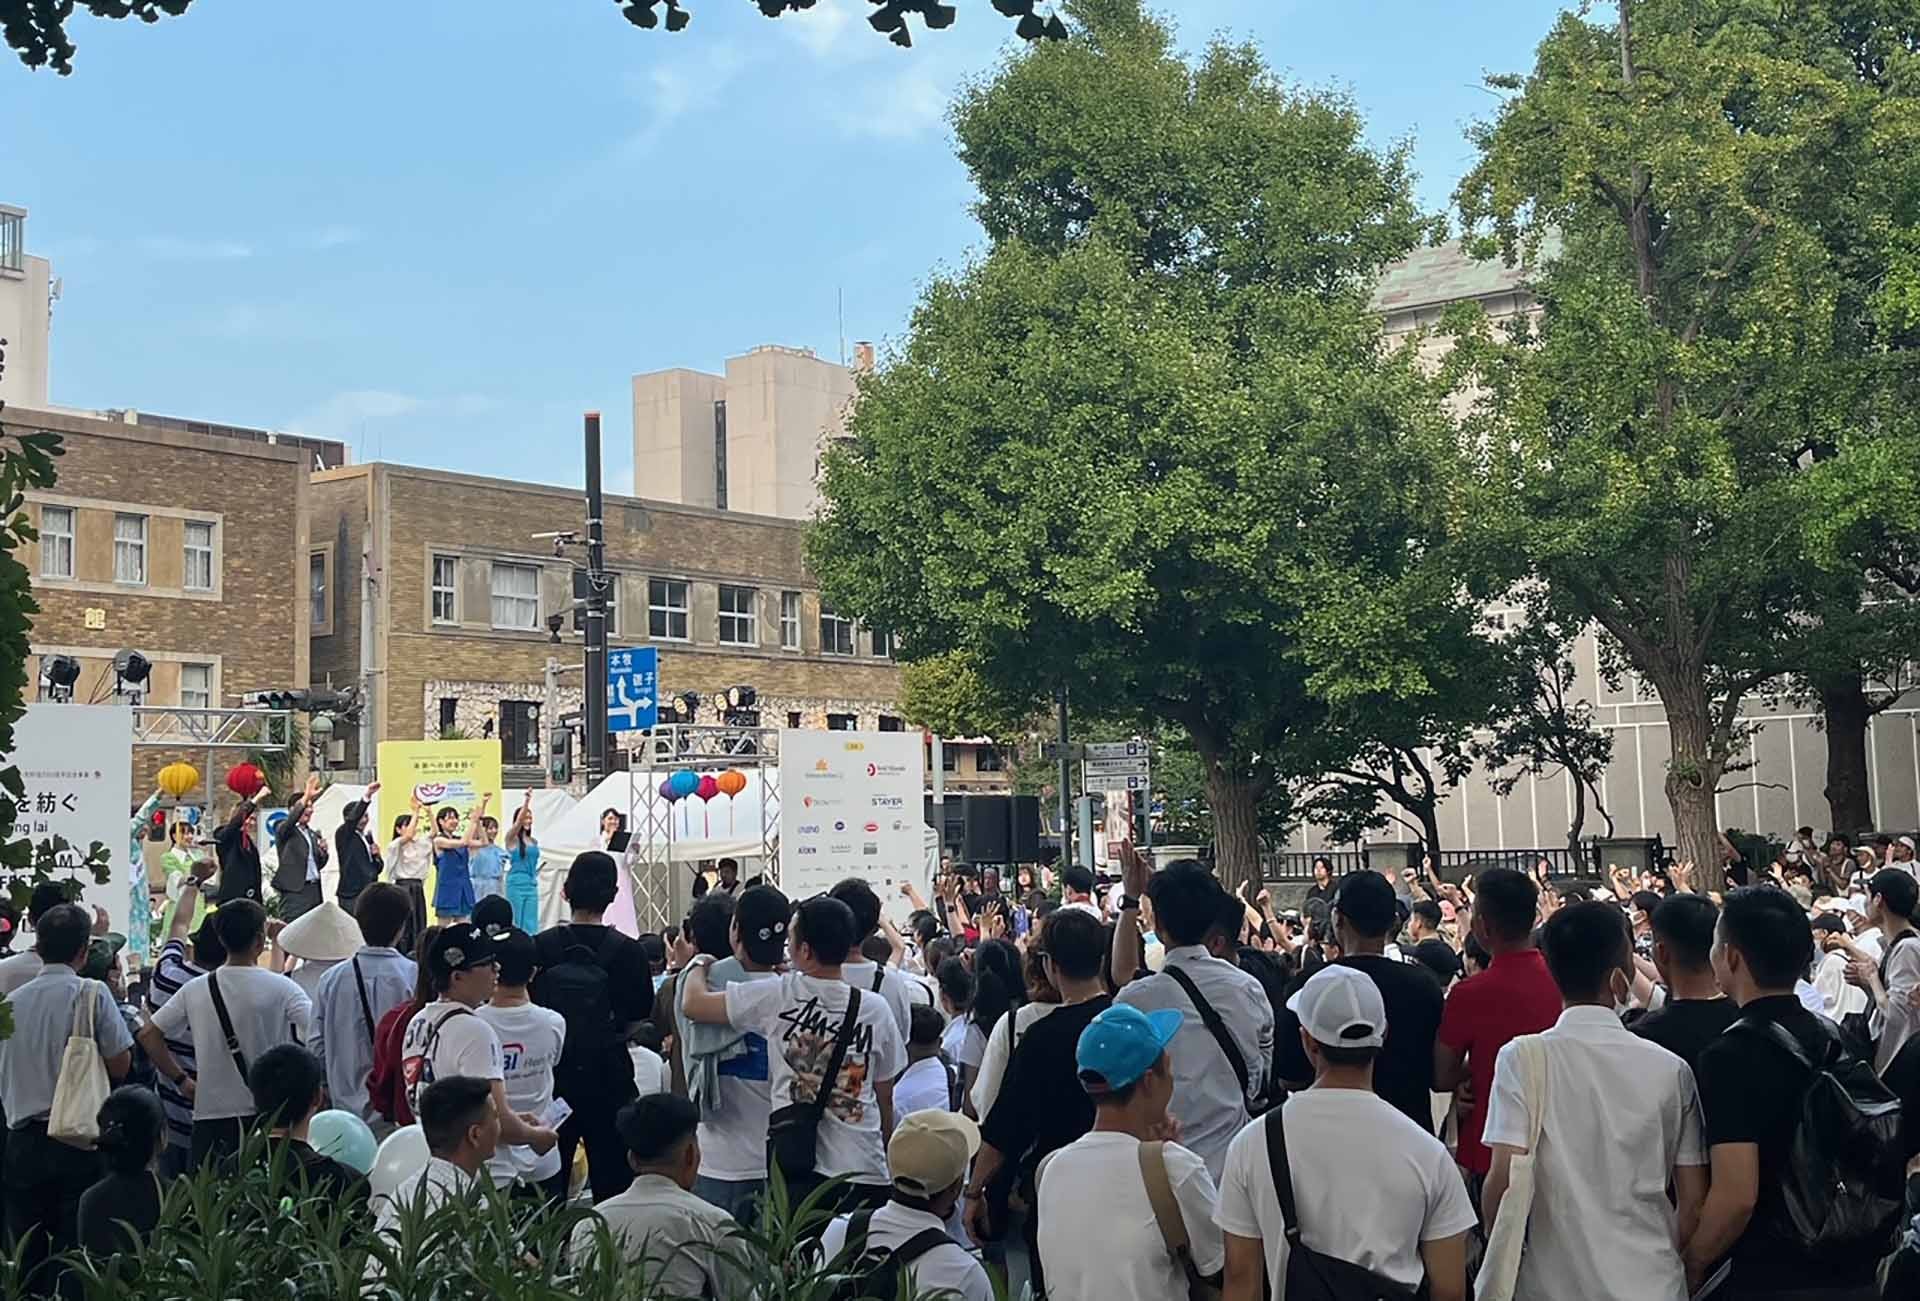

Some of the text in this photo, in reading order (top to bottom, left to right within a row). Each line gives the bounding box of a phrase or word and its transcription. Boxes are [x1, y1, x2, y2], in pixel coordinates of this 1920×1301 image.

[0, 791, 78, 814] を紡ぐ
[15, 820, 48, 836] ng lai
